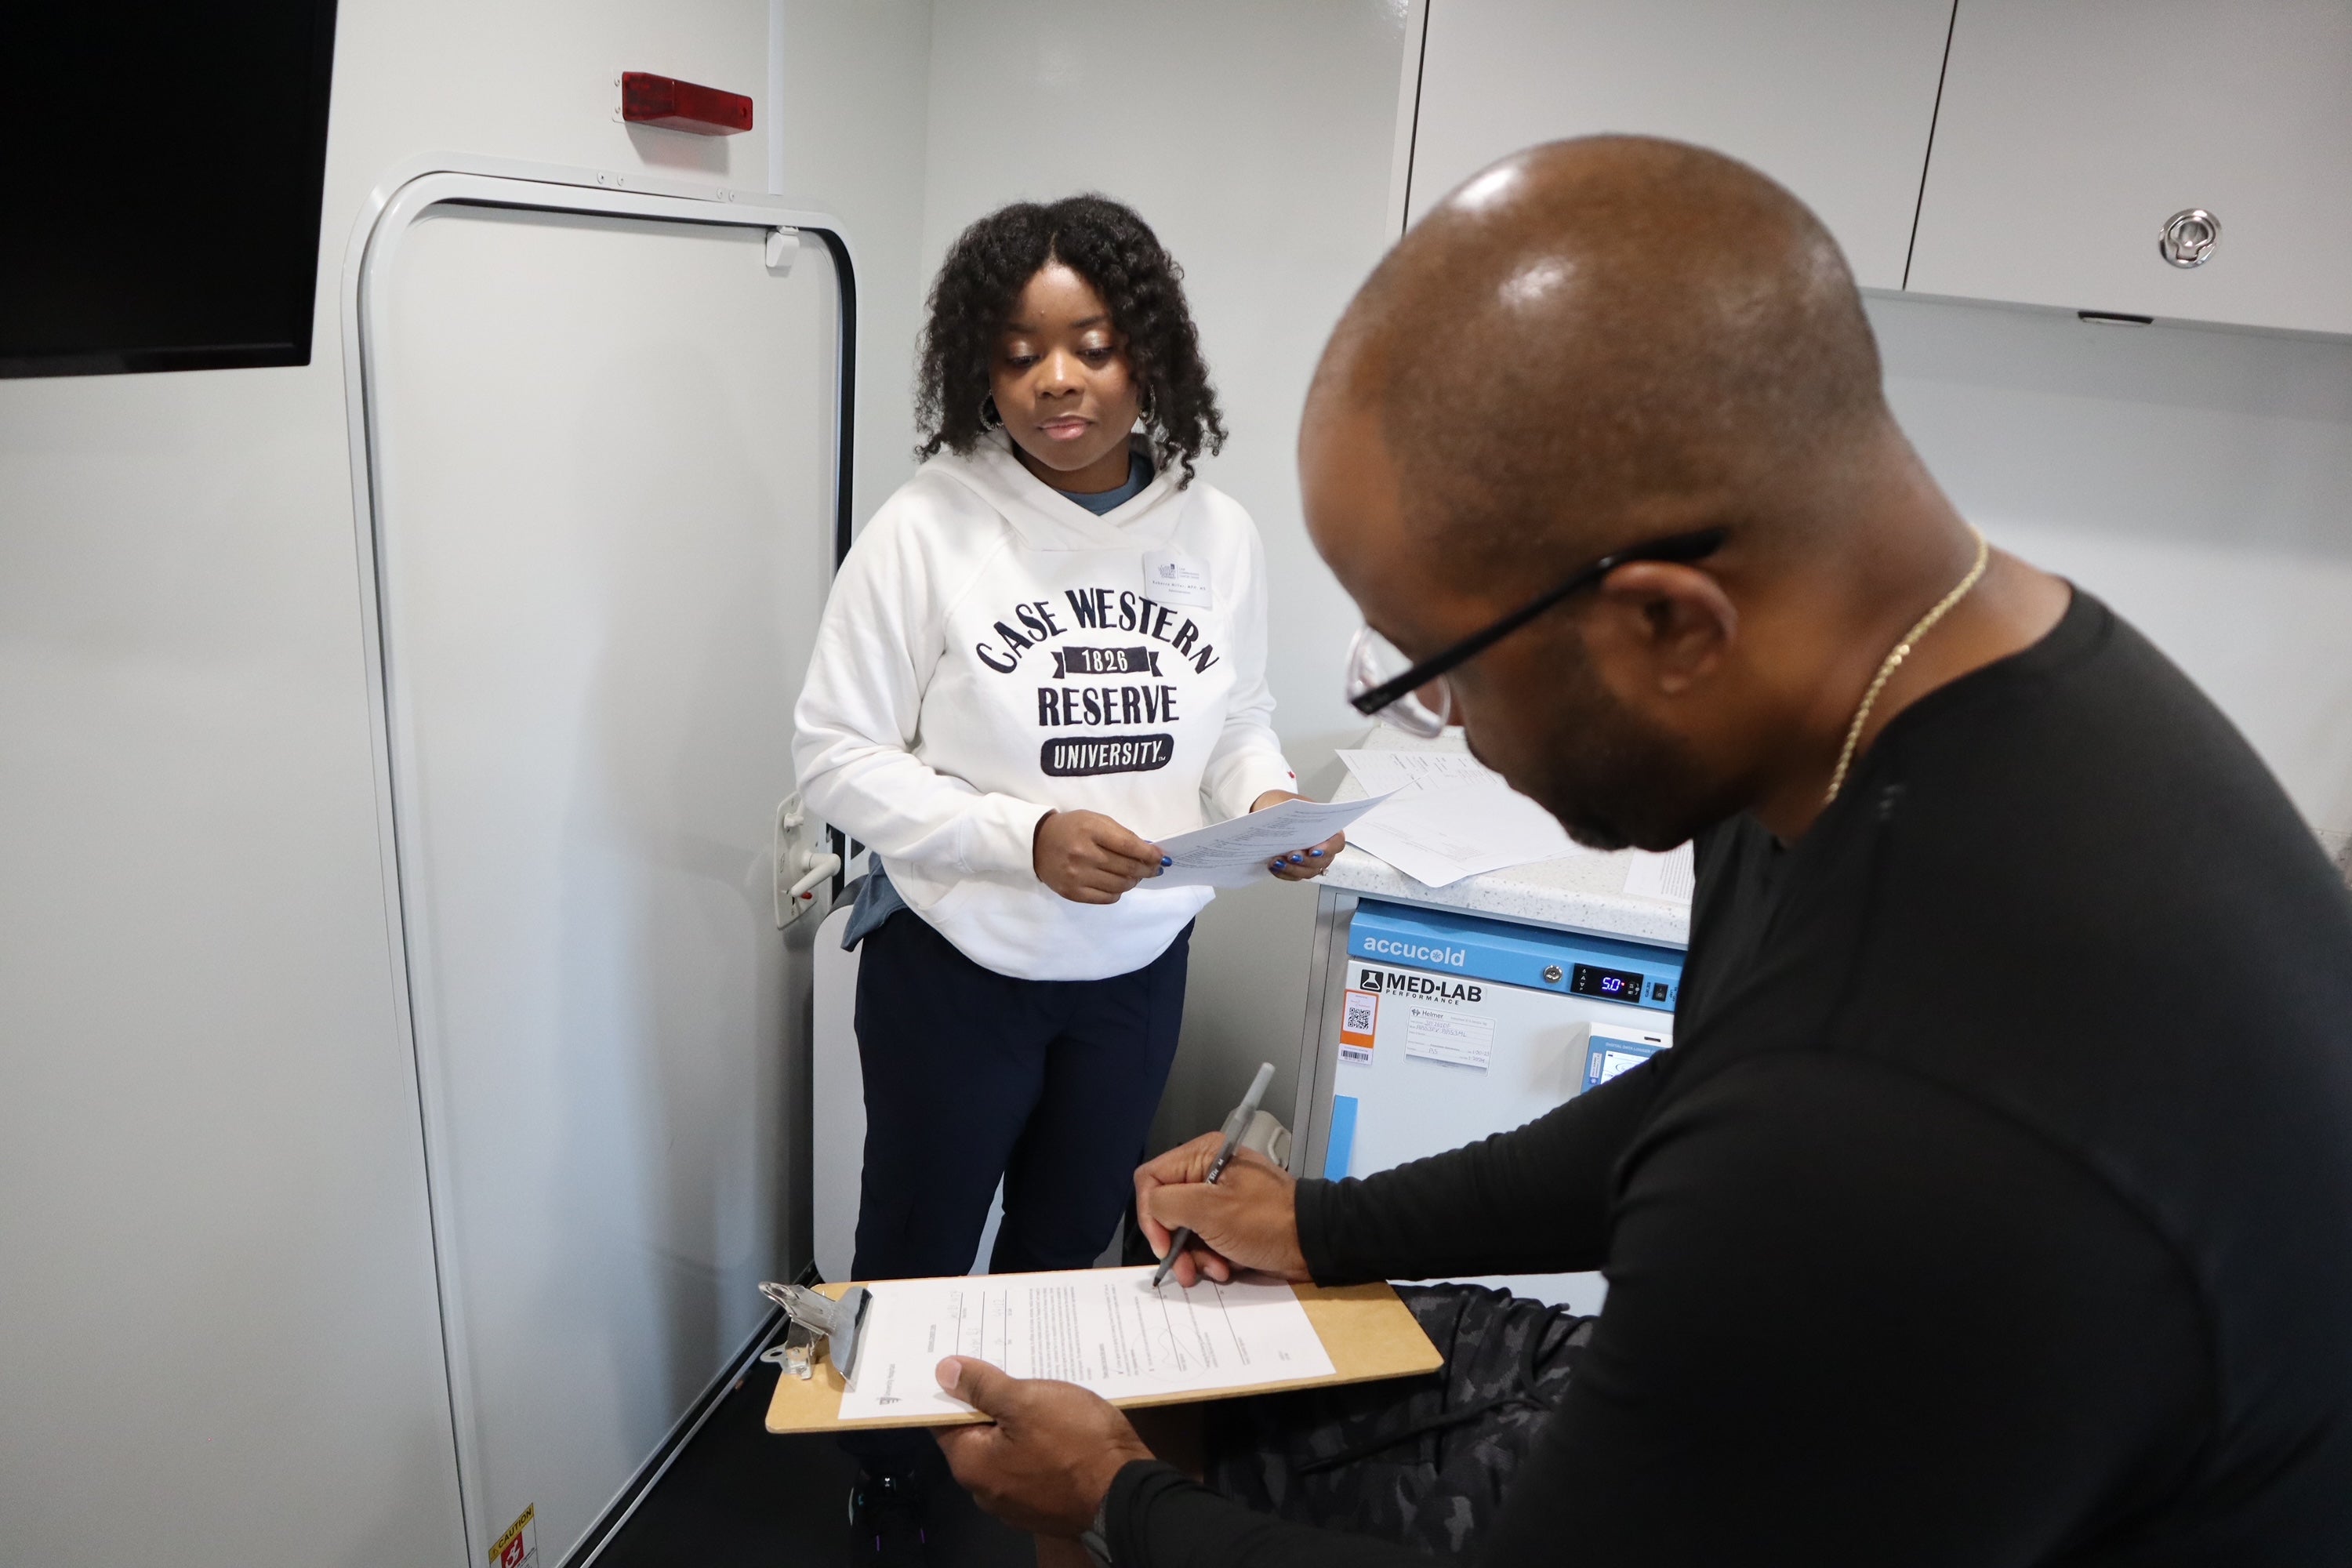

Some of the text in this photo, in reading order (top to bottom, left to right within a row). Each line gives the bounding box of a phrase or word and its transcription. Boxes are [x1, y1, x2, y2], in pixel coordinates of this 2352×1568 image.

[976, 587, 1219, 674] CASE WESTERN
[1081, 650, 1128, 672] 1826
[1038, 685, 1179, 726] RESERVE
[1054, 740, 1163, 770] UNIVERSITY
[1363, 937, 1465, 967] accucold
[1385, 989, 1459, 1005] PERFORMANCE
[1422, 1010, 1443, 1019] Helmer
[499, 1508, 532, 1548] CAUTION
